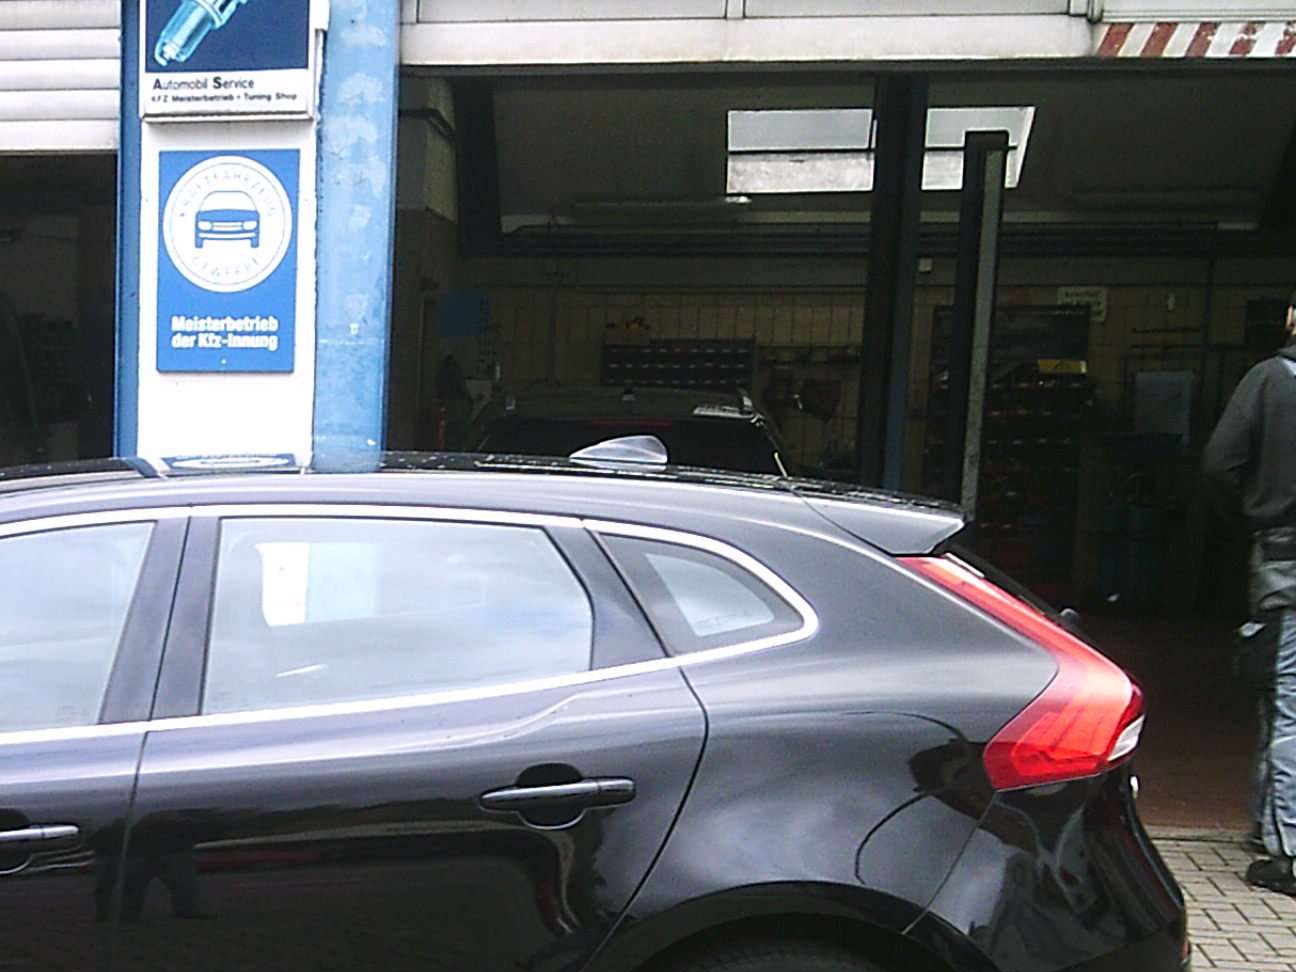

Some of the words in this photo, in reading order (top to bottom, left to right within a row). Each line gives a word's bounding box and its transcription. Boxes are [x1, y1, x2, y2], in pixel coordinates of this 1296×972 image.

[153, 77, 209, 91] Automobil
[212, 76, 255, 90] Service
[171, 315, 279, 332] Meisterbetrieb
[171, 332, 197, 348] der
